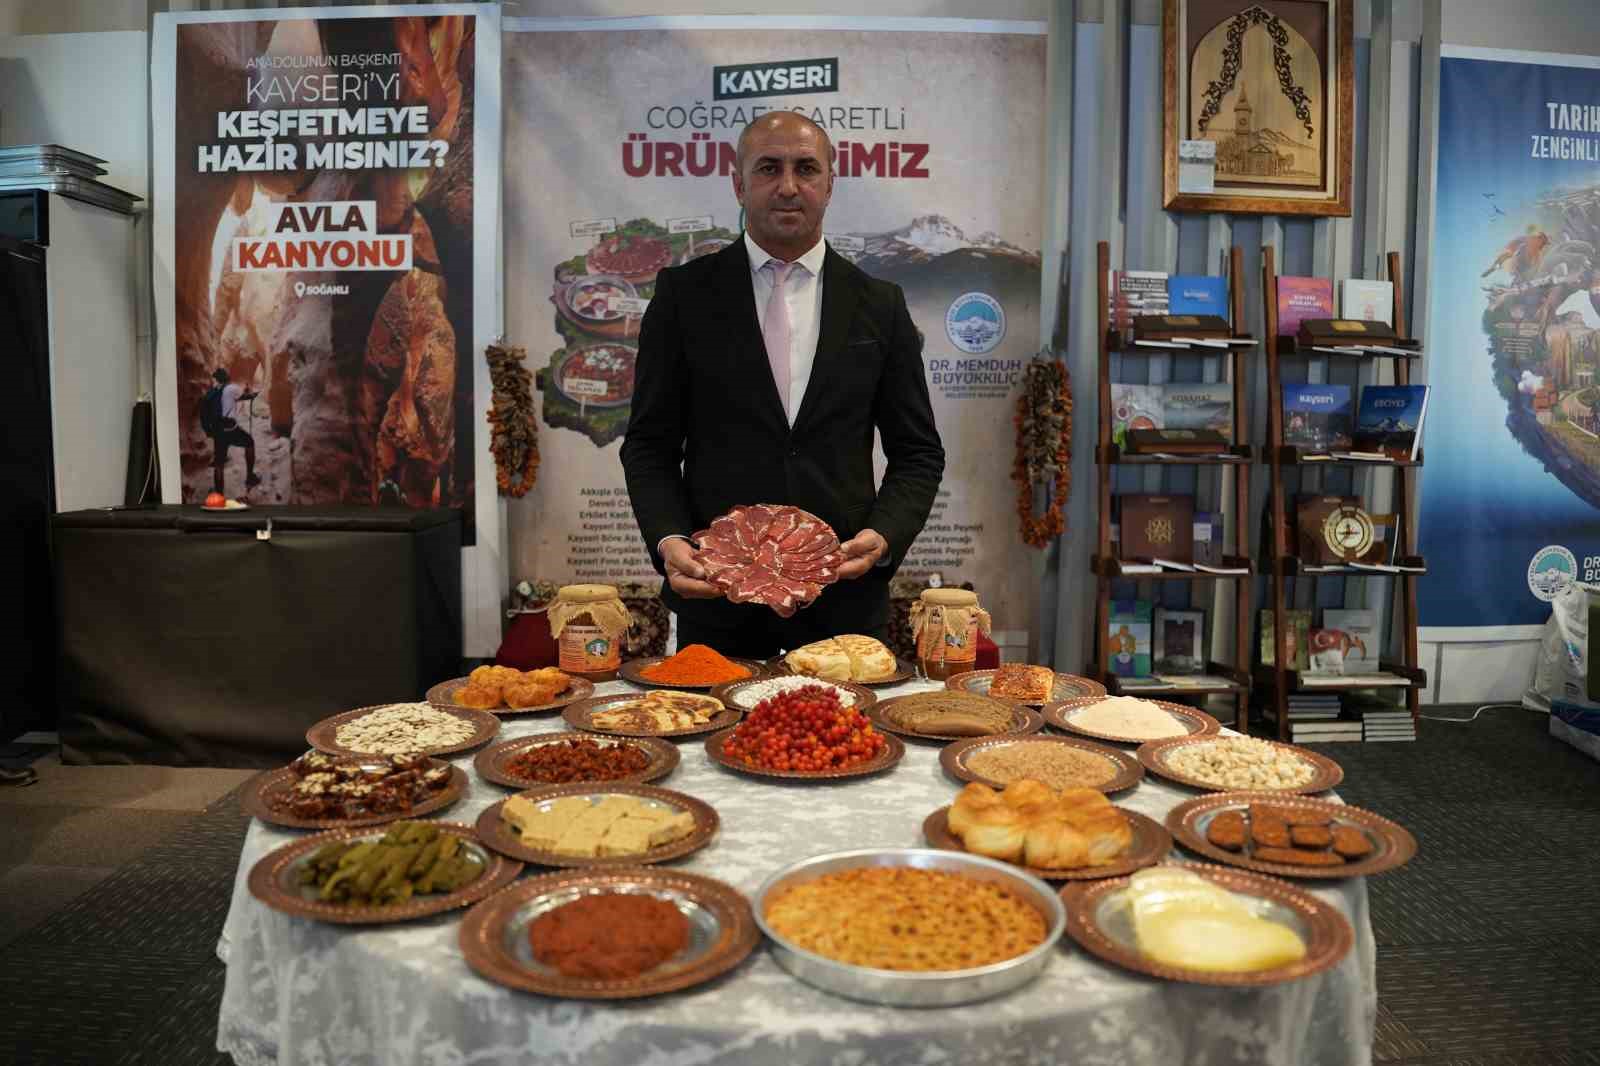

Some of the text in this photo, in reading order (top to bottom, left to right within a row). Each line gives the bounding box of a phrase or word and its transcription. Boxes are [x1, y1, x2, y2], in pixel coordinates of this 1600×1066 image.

[246, 56, 337, 69] ANADOLUNUN
[218, 106, 429, 143] KEŞFETMEYE
[647, 102, 773, 130] COĞRAF
[198, 140, 449, 172] HAZIR MISINIZ?
[275, 206, 367, 233] AVLA
[239, 240, 405, 268] KANYONU
[929, 360, 1022, 371] DR. MEMDUH
